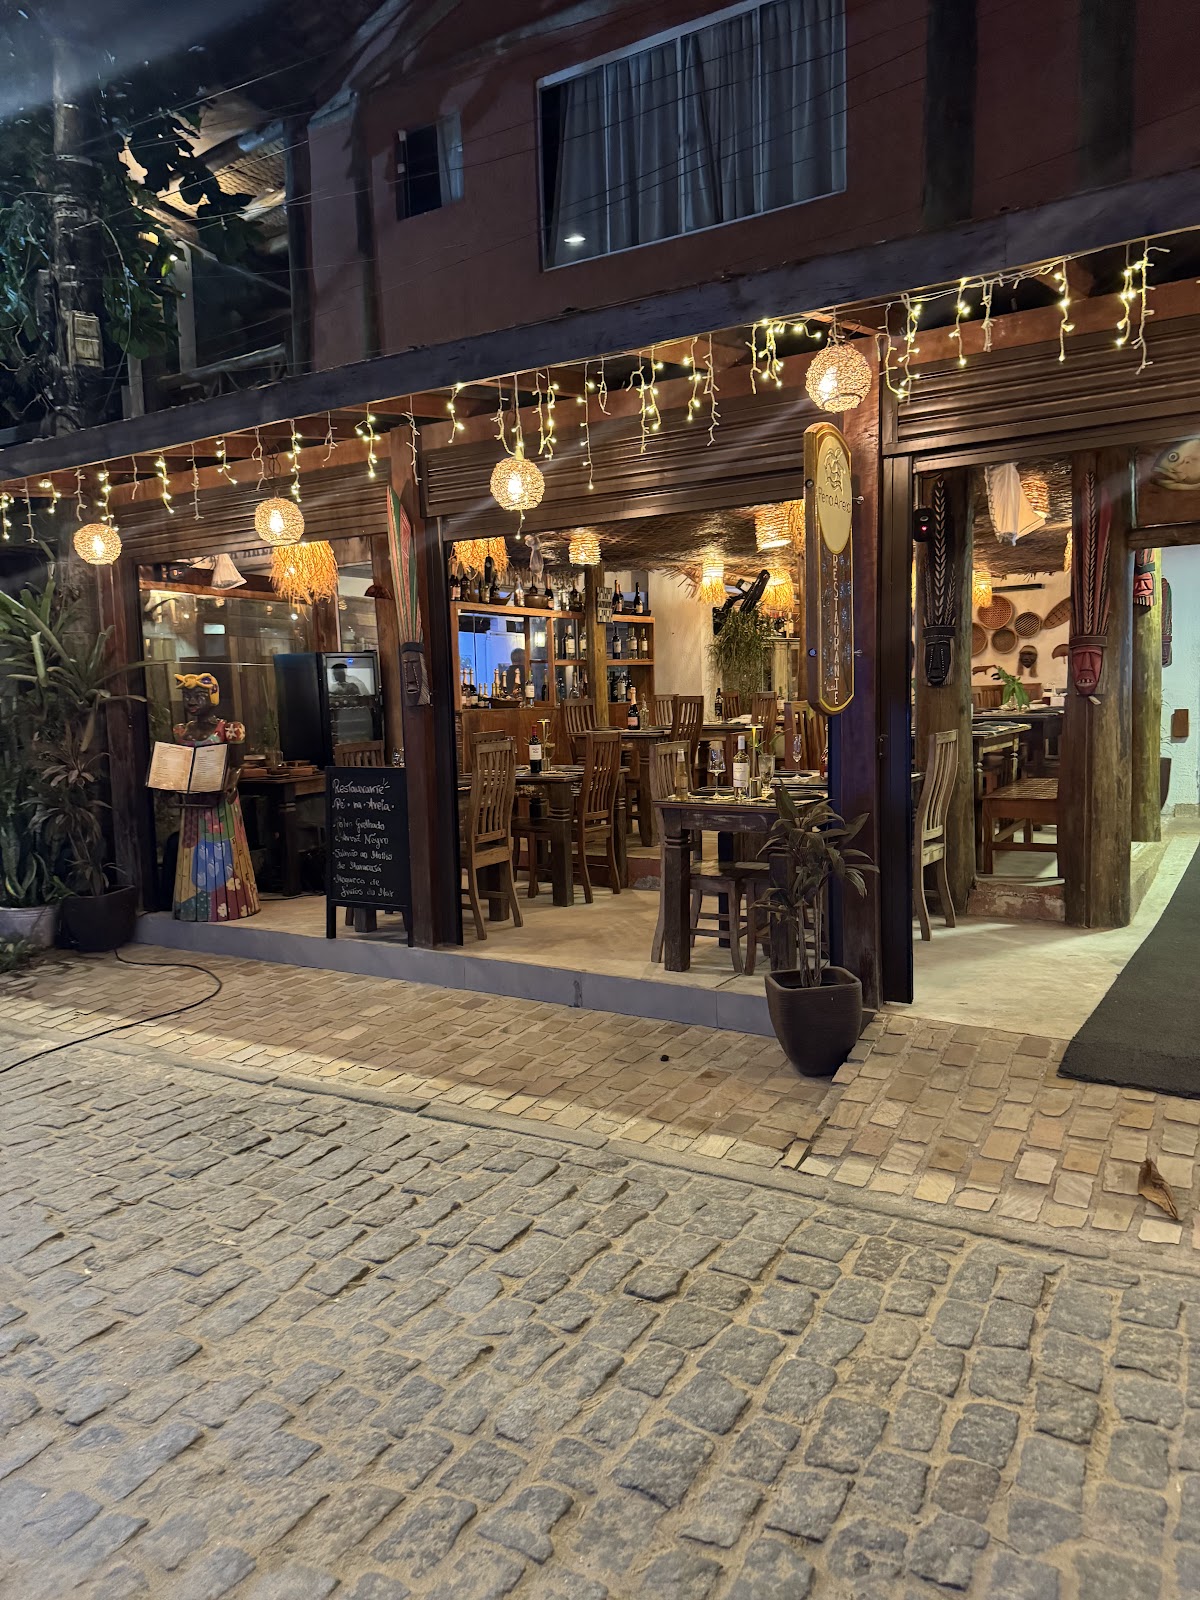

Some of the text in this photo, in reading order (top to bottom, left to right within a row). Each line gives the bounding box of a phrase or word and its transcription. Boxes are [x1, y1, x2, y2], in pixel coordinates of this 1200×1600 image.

[832, 554, 840, 705] RESTAURANTE
[332, 779, 385, 794] Restaurante
[332, 798, 345, 810] Pé
[353, 801, 362, 809] na
[364, 833, 389, 849] Negro
